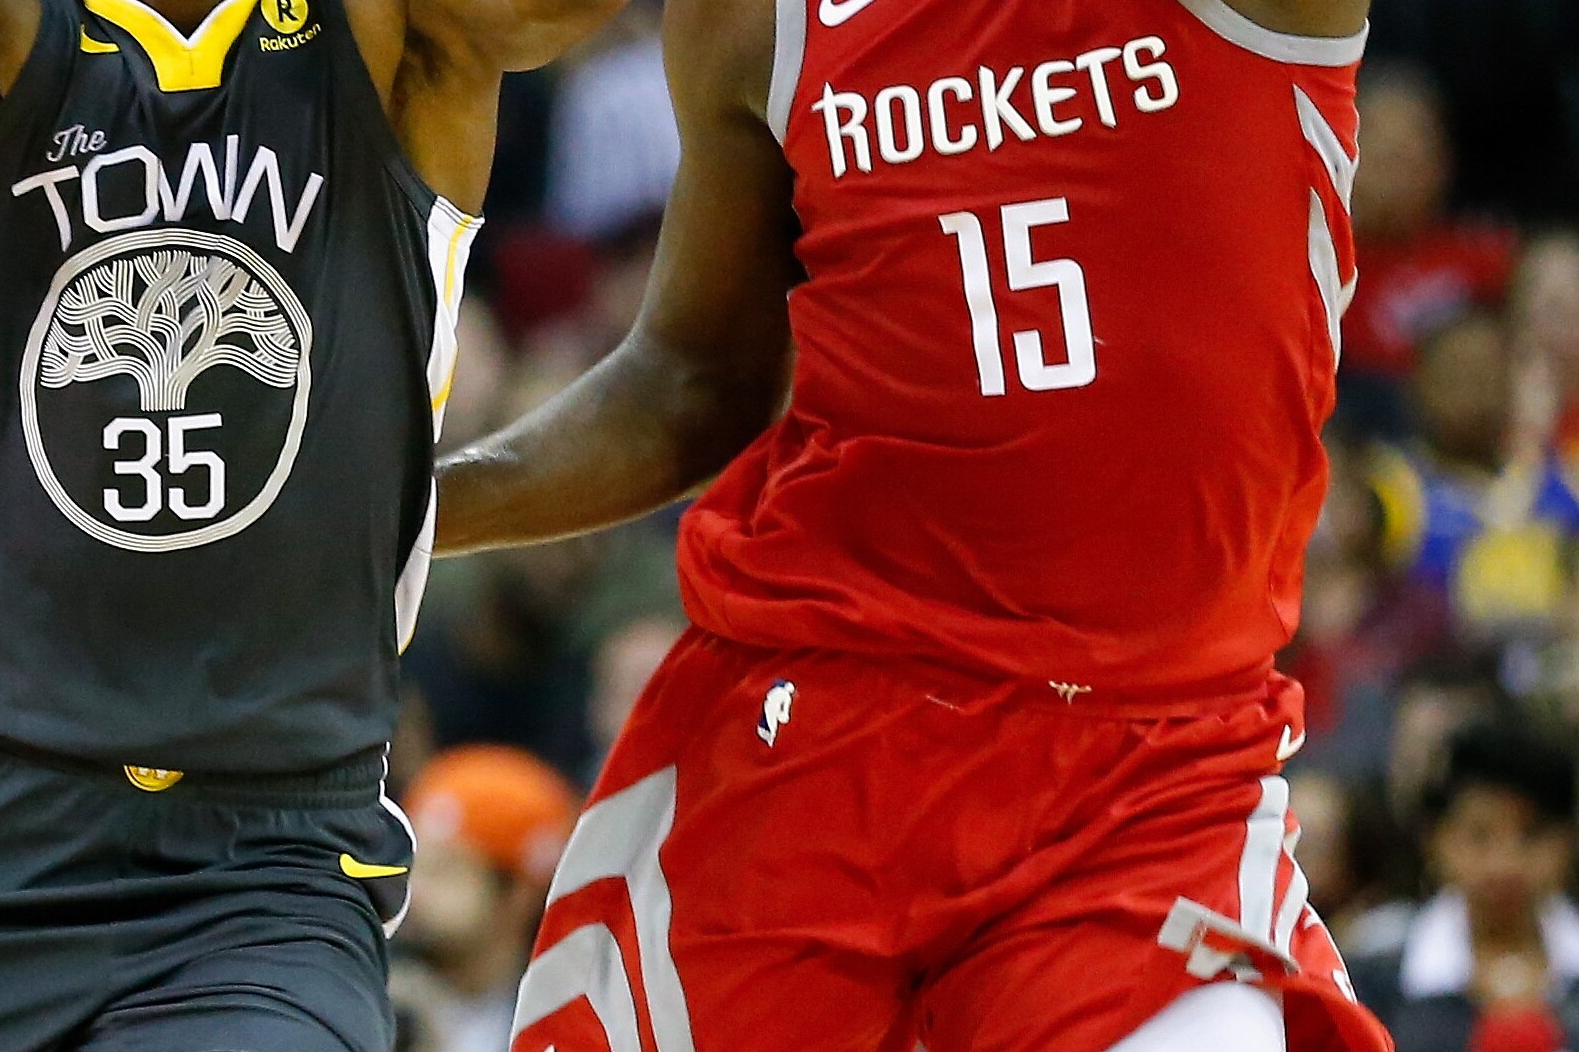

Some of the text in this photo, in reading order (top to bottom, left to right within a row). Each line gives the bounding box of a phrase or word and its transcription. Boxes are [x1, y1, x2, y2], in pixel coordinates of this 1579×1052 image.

[259, 23, 321, 52] Rakuten
[46, 124, 107, 162] The
[812, 35, 1179, 178] ROCKETS
[11, 134, 323, 253] TOWN
[938, 197, 1097, 396] 15
[103, 413, 225, 522] 35
